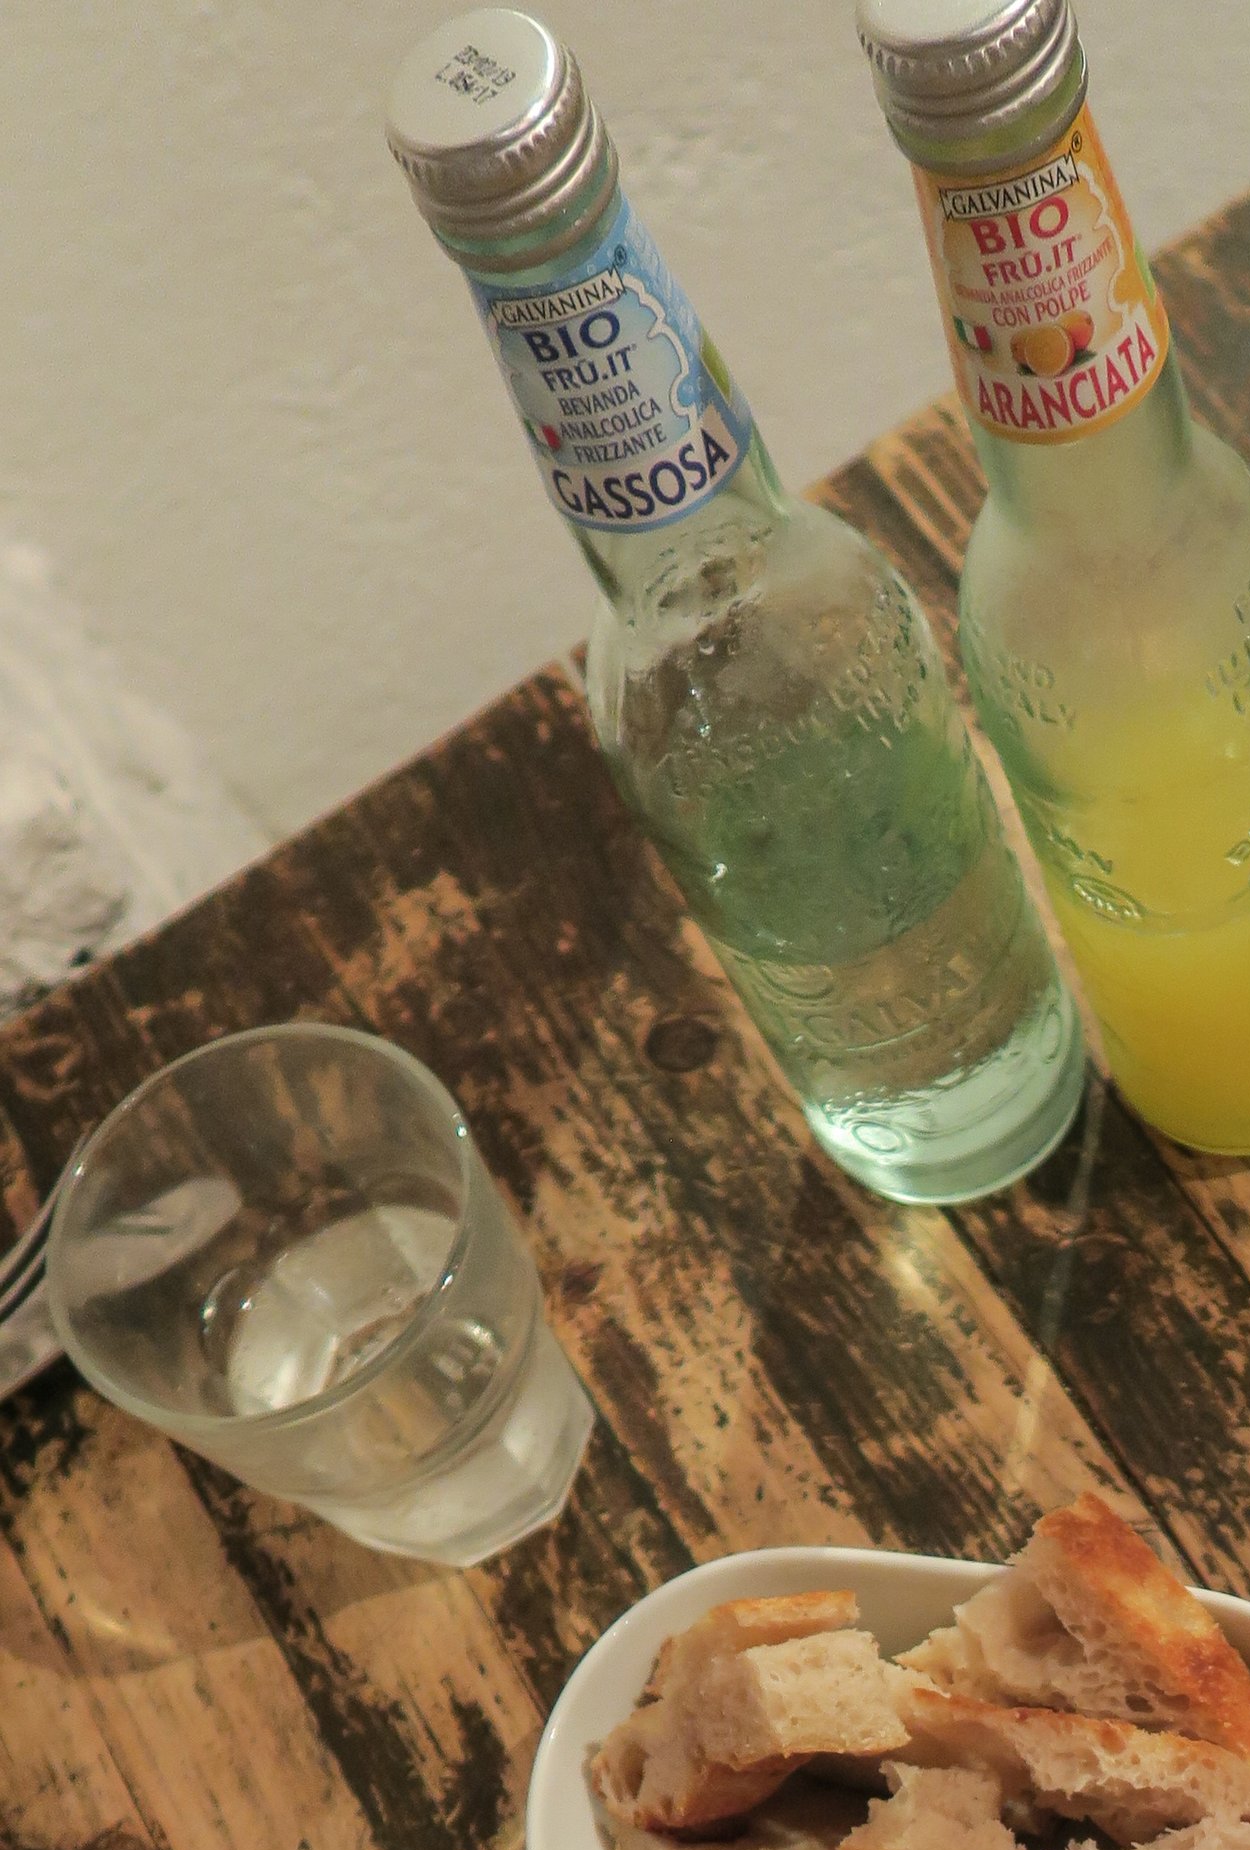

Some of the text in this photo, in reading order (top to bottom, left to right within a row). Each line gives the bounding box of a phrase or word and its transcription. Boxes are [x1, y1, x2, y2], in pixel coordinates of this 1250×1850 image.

[952, 166, 1068, 215] GALVANINA
[970, 195, 1069, 255] BIO
[502, 279, 614, 323] GALVANINA
[992, 280, 1091, 327] CON POLPE
[523, 311, 620, 363] BIO
[558, 379, 640, 416] BEVANDA
[978, 322, 1155, 430] ARANCIATA
[559, 398, 663, 440] ANALCOLICA
[572, 423, 667, 464] FRIZZANTE
[553, 428, 730, 519] GASSOSA
